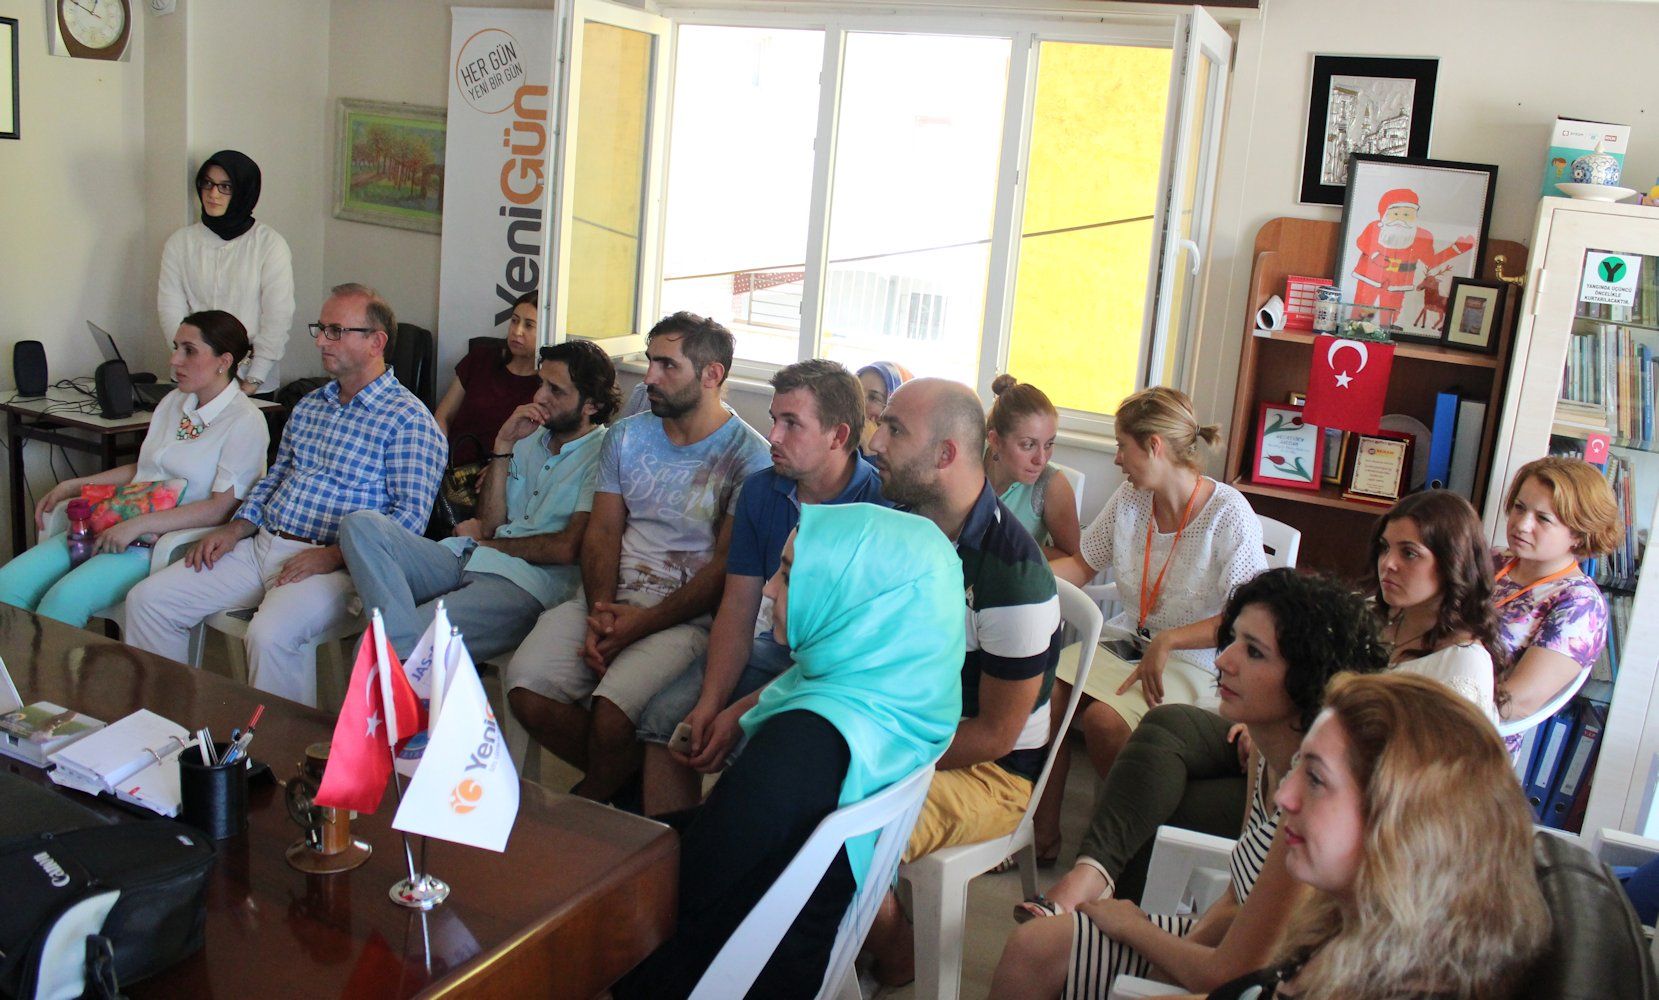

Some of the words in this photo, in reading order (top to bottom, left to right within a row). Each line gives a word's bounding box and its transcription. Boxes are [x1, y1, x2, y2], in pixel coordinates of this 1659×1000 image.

[460, 58, 489, 87] HER
[488, 41, 517, 71] GÜN
[503, 62, 523, 82] GÜN
[1602, 261, 1623, 282] Y
[33, 851, 70, 887] Canon
